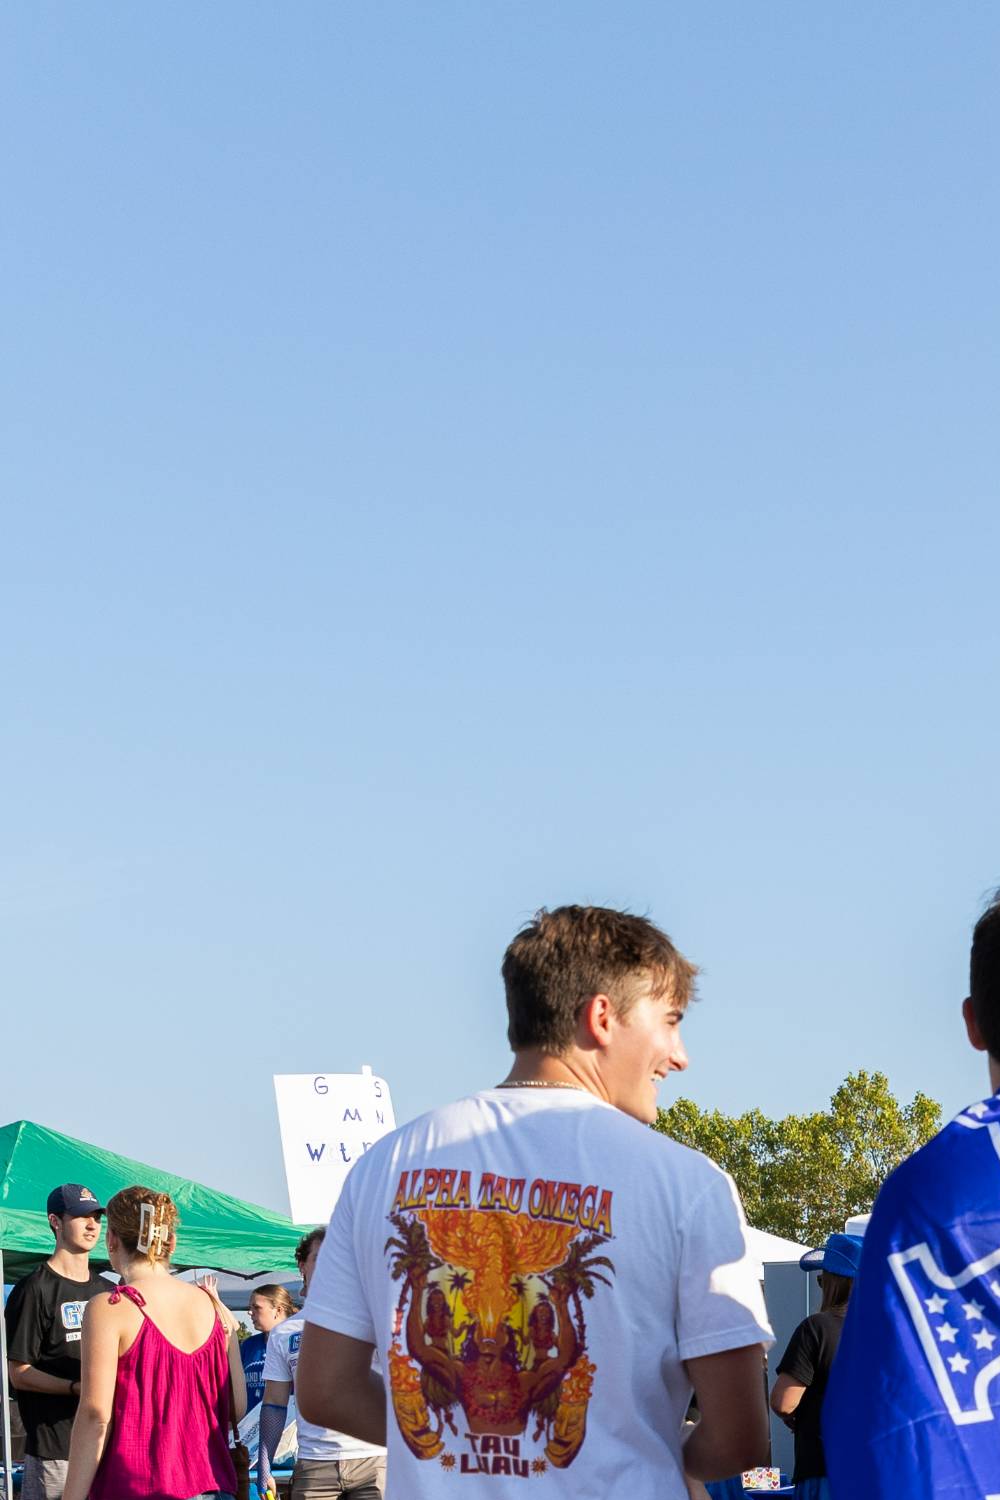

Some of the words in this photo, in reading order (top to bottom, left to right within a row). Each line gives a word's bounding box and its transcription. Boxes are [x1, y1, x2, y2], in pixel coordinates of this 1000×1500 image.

[391, 1168, 472, 1214] ALPHA
[477, 1172, 527, 1214] TAU
[528, 1178, 614, 1238] OMEGA
[464, 1432, 520, 1457] TAU
[460, 1453, 529, 1478] LUAU
